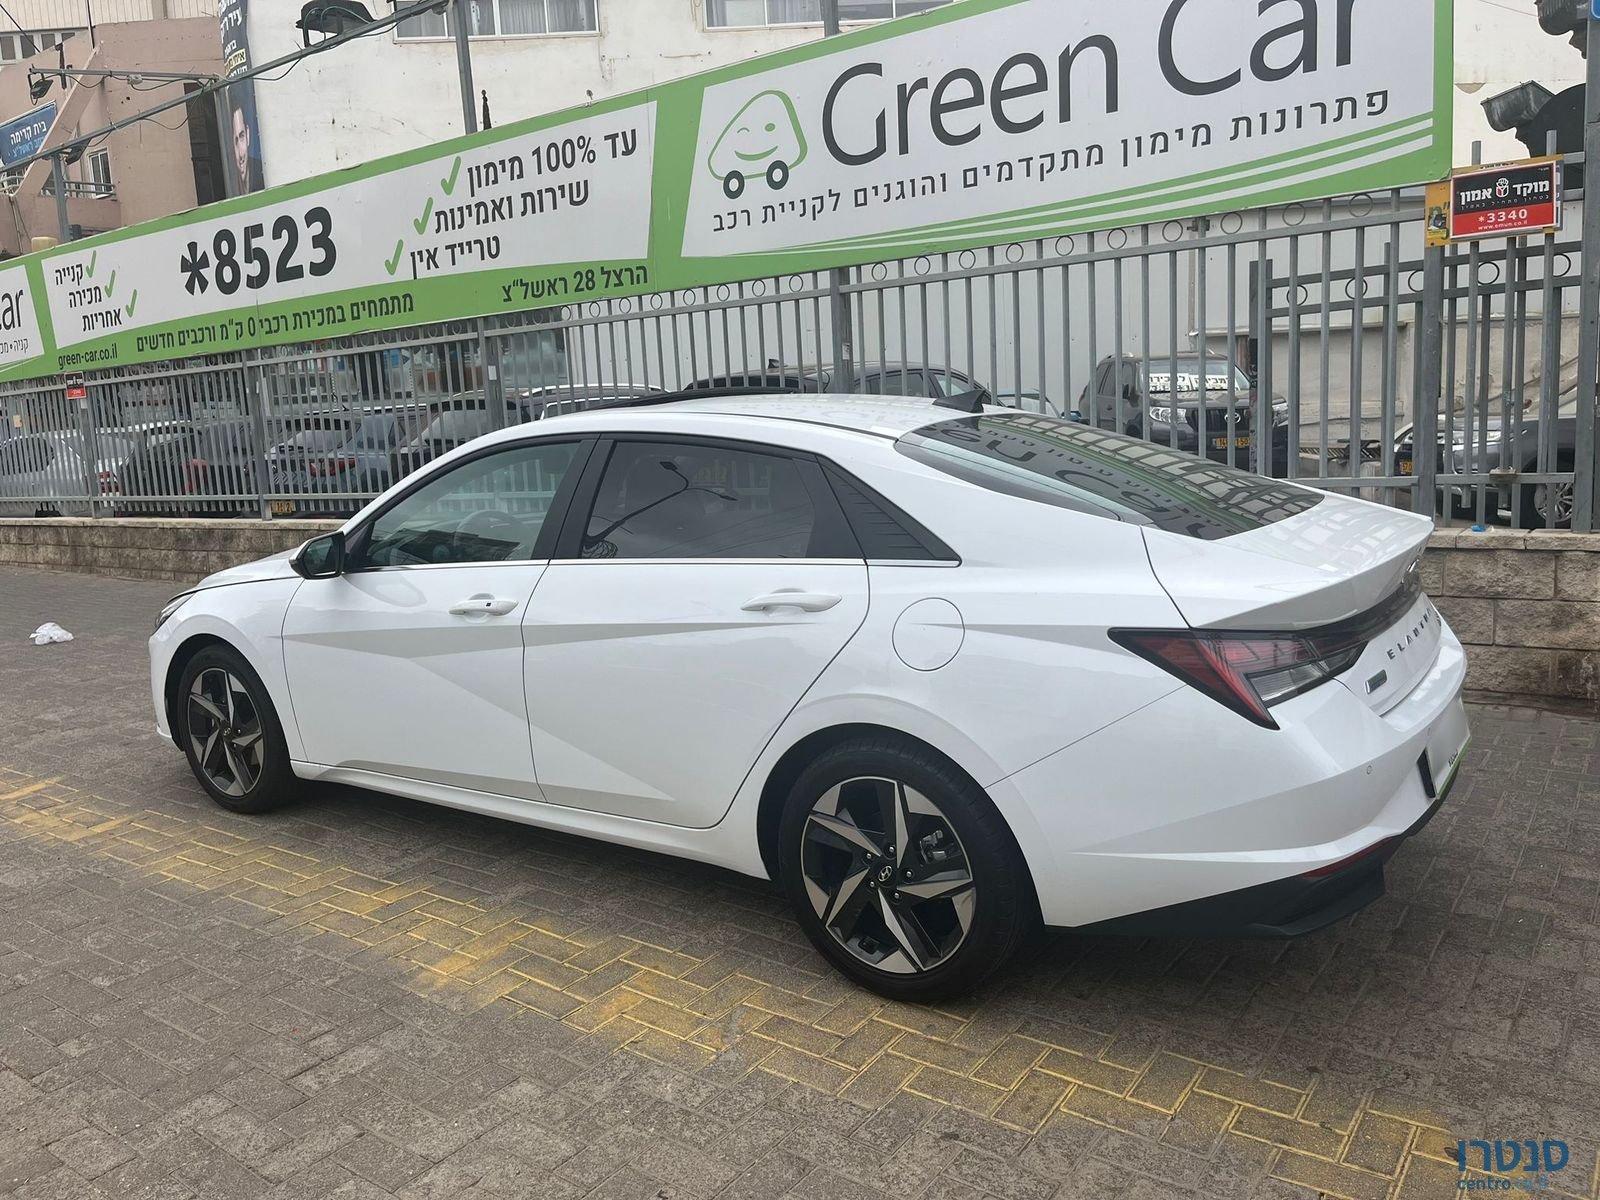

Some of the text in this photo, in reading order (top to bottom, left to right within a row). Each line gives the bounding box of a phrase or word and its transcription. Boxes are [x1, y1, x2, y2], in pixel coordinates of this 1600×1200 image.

[822, 0, 1355, 166] Green Car
[10, 125, 32, 145] קדימה
[33, 121, 47, 135] בית
[467, 128, 637, 198] עד 100% מימון
[713, 89, 1389, 232] פתרונות מימון מתקדמים והוגנים לקניית רכב
[1460, 187, 1492, 206] אמון
[1512, 180, 1550, 196] מוקד
[434, 179, 589, 234] שירות ואמינות
[410, 235, 501, 281] טרייד אין
[55, 263, 84, 287] קנייה
[573, 268, 597, 293] 28
[600, 265, 648, 290] הרצל
[68, 285, 103, 309] מכירה
[349, 293, 414, 321] מתמחים
[0, 289, 24, 330] ar
[82, 308, 122, 332] אחריות
[292, 305, 347, 331] במכירת
[177, 325, 217, 347] ורכבים
[247, 316, 257, 337] 0
[258, 314, 289, 335] רכבי
[136, 333, 175, 353] חדשים
[58, 343, 118, 370] green-car.co.il
